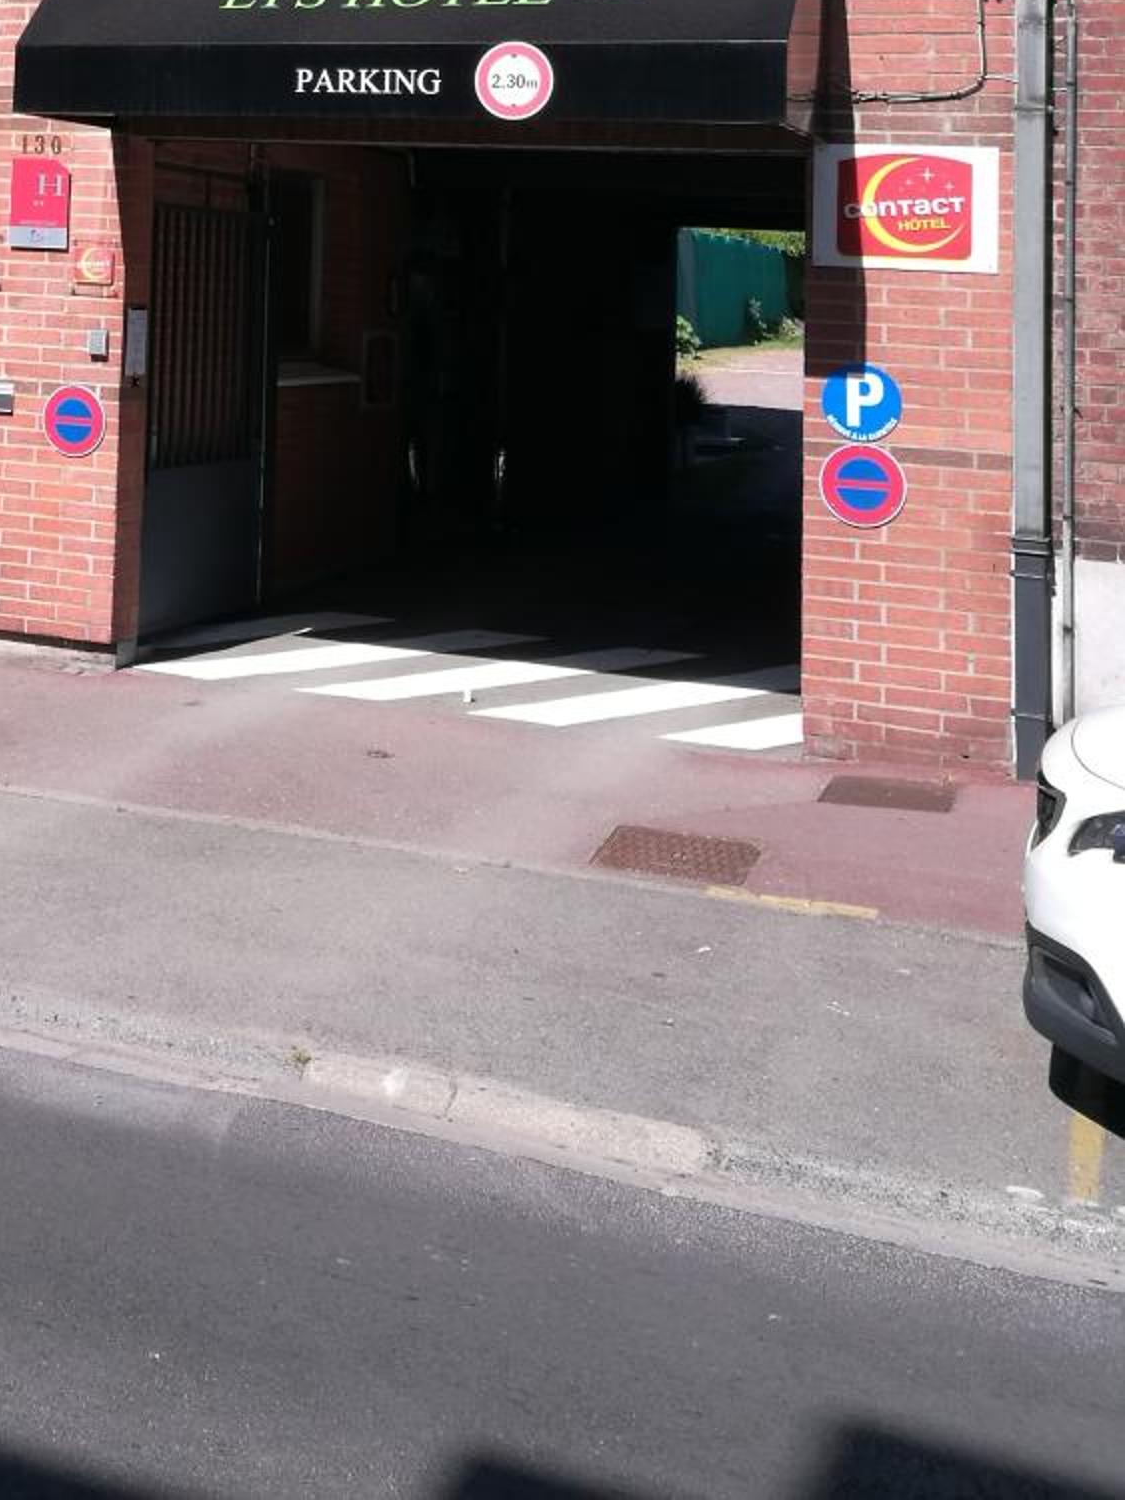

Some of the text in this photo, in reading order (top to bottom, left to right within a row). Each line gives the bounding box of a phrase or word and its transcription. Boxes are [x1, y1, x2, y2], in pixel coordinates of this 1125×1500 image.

[293, 68, 442, 95] PARKING
[897, 217, 952, 231] HOTEL
[845, 372, 885, 428] P
